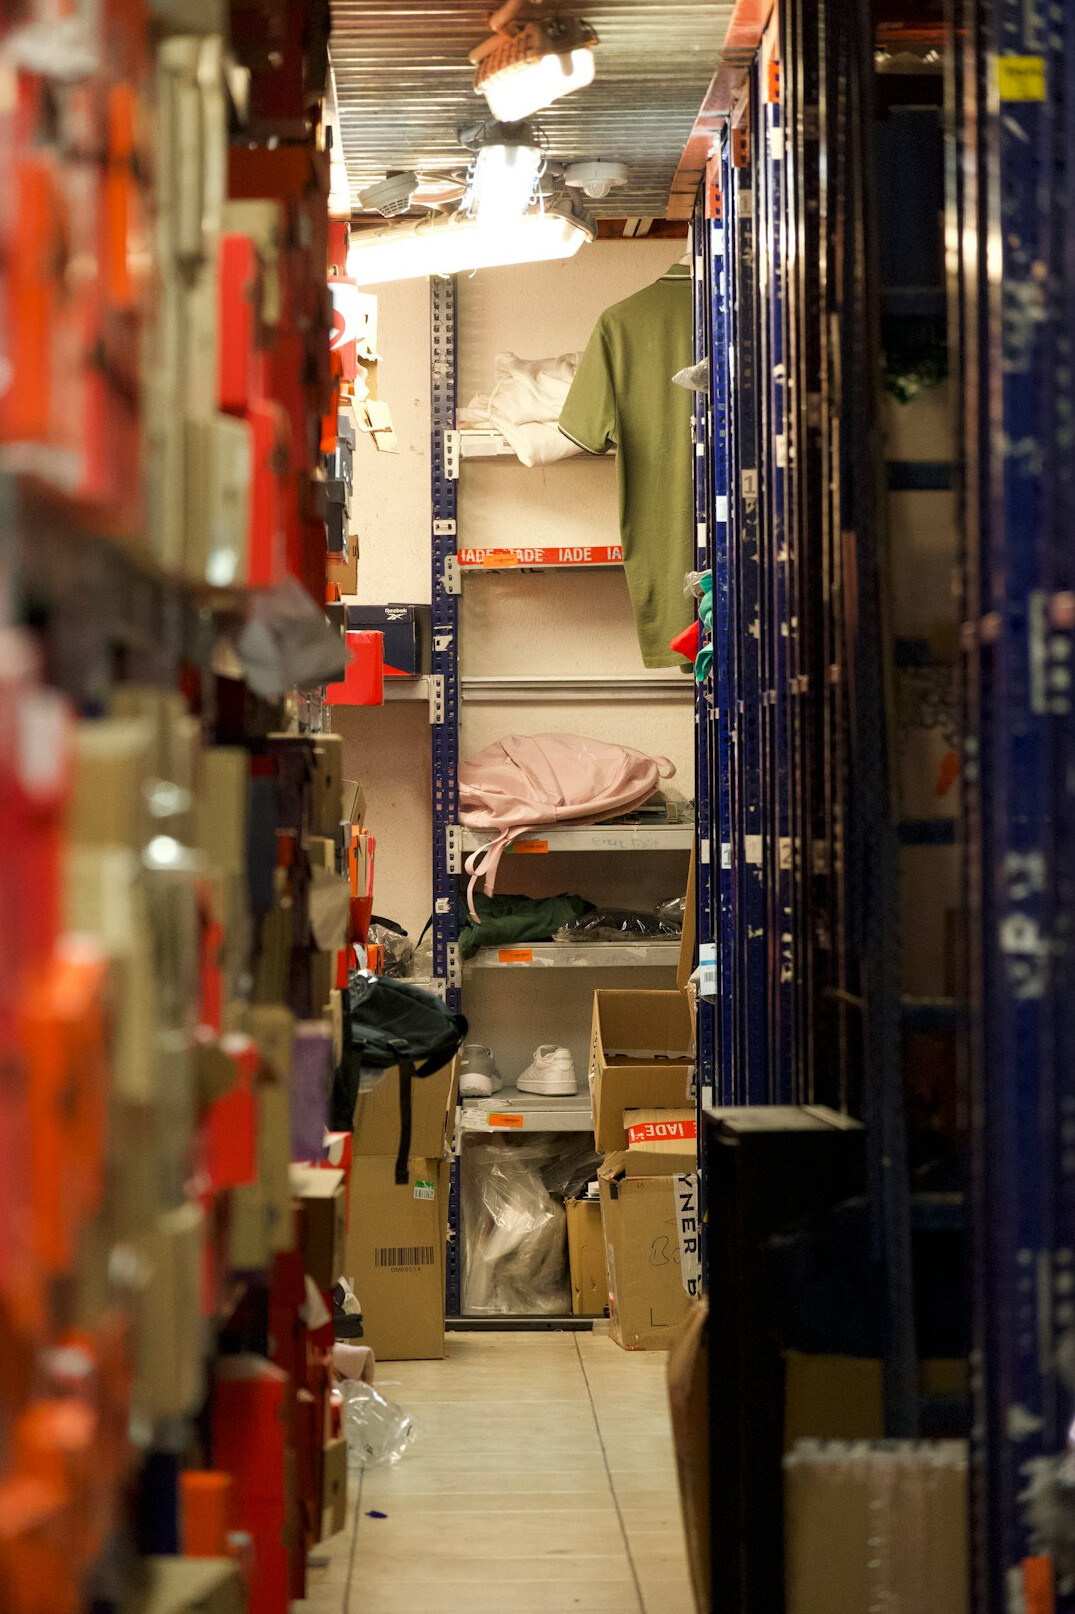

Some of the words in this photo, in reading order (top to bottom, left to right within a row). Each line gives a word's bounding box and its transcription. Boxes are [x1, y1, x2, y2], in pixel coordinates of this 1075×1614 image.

[744, 475, 756, 494] 1
[510, 548, 544, 562] ADE
[558, 547, 592, 562] IADE
[645, 1122, 684, 1137] IADE
[678, 1173, 697, 1254] YNER
